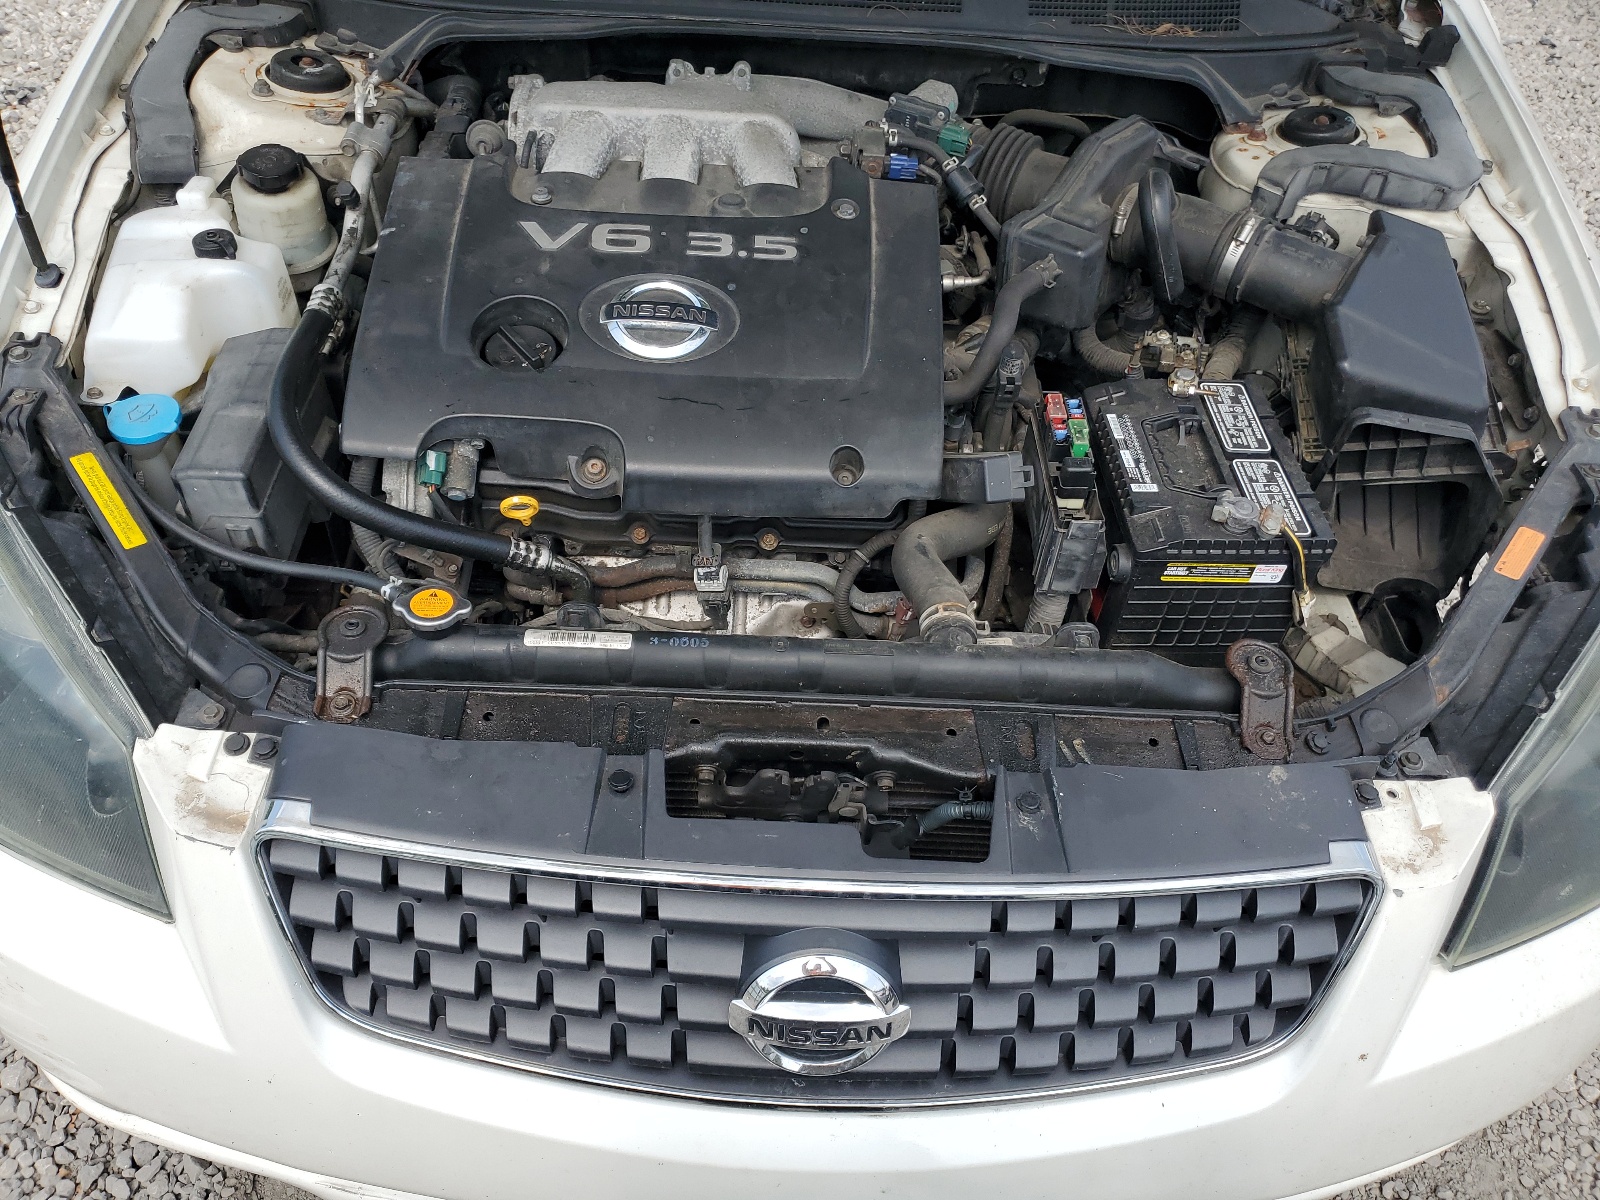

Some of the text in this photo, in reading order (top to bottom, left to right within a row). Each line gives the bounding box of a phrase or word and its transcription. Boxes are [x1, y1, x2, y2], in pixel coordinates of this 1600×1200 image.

[518, 221, 798, 261] V6 3.5
[612, 303, 707, 324] NISSAN
[747, 1016, 893, 1046] NISSAN
